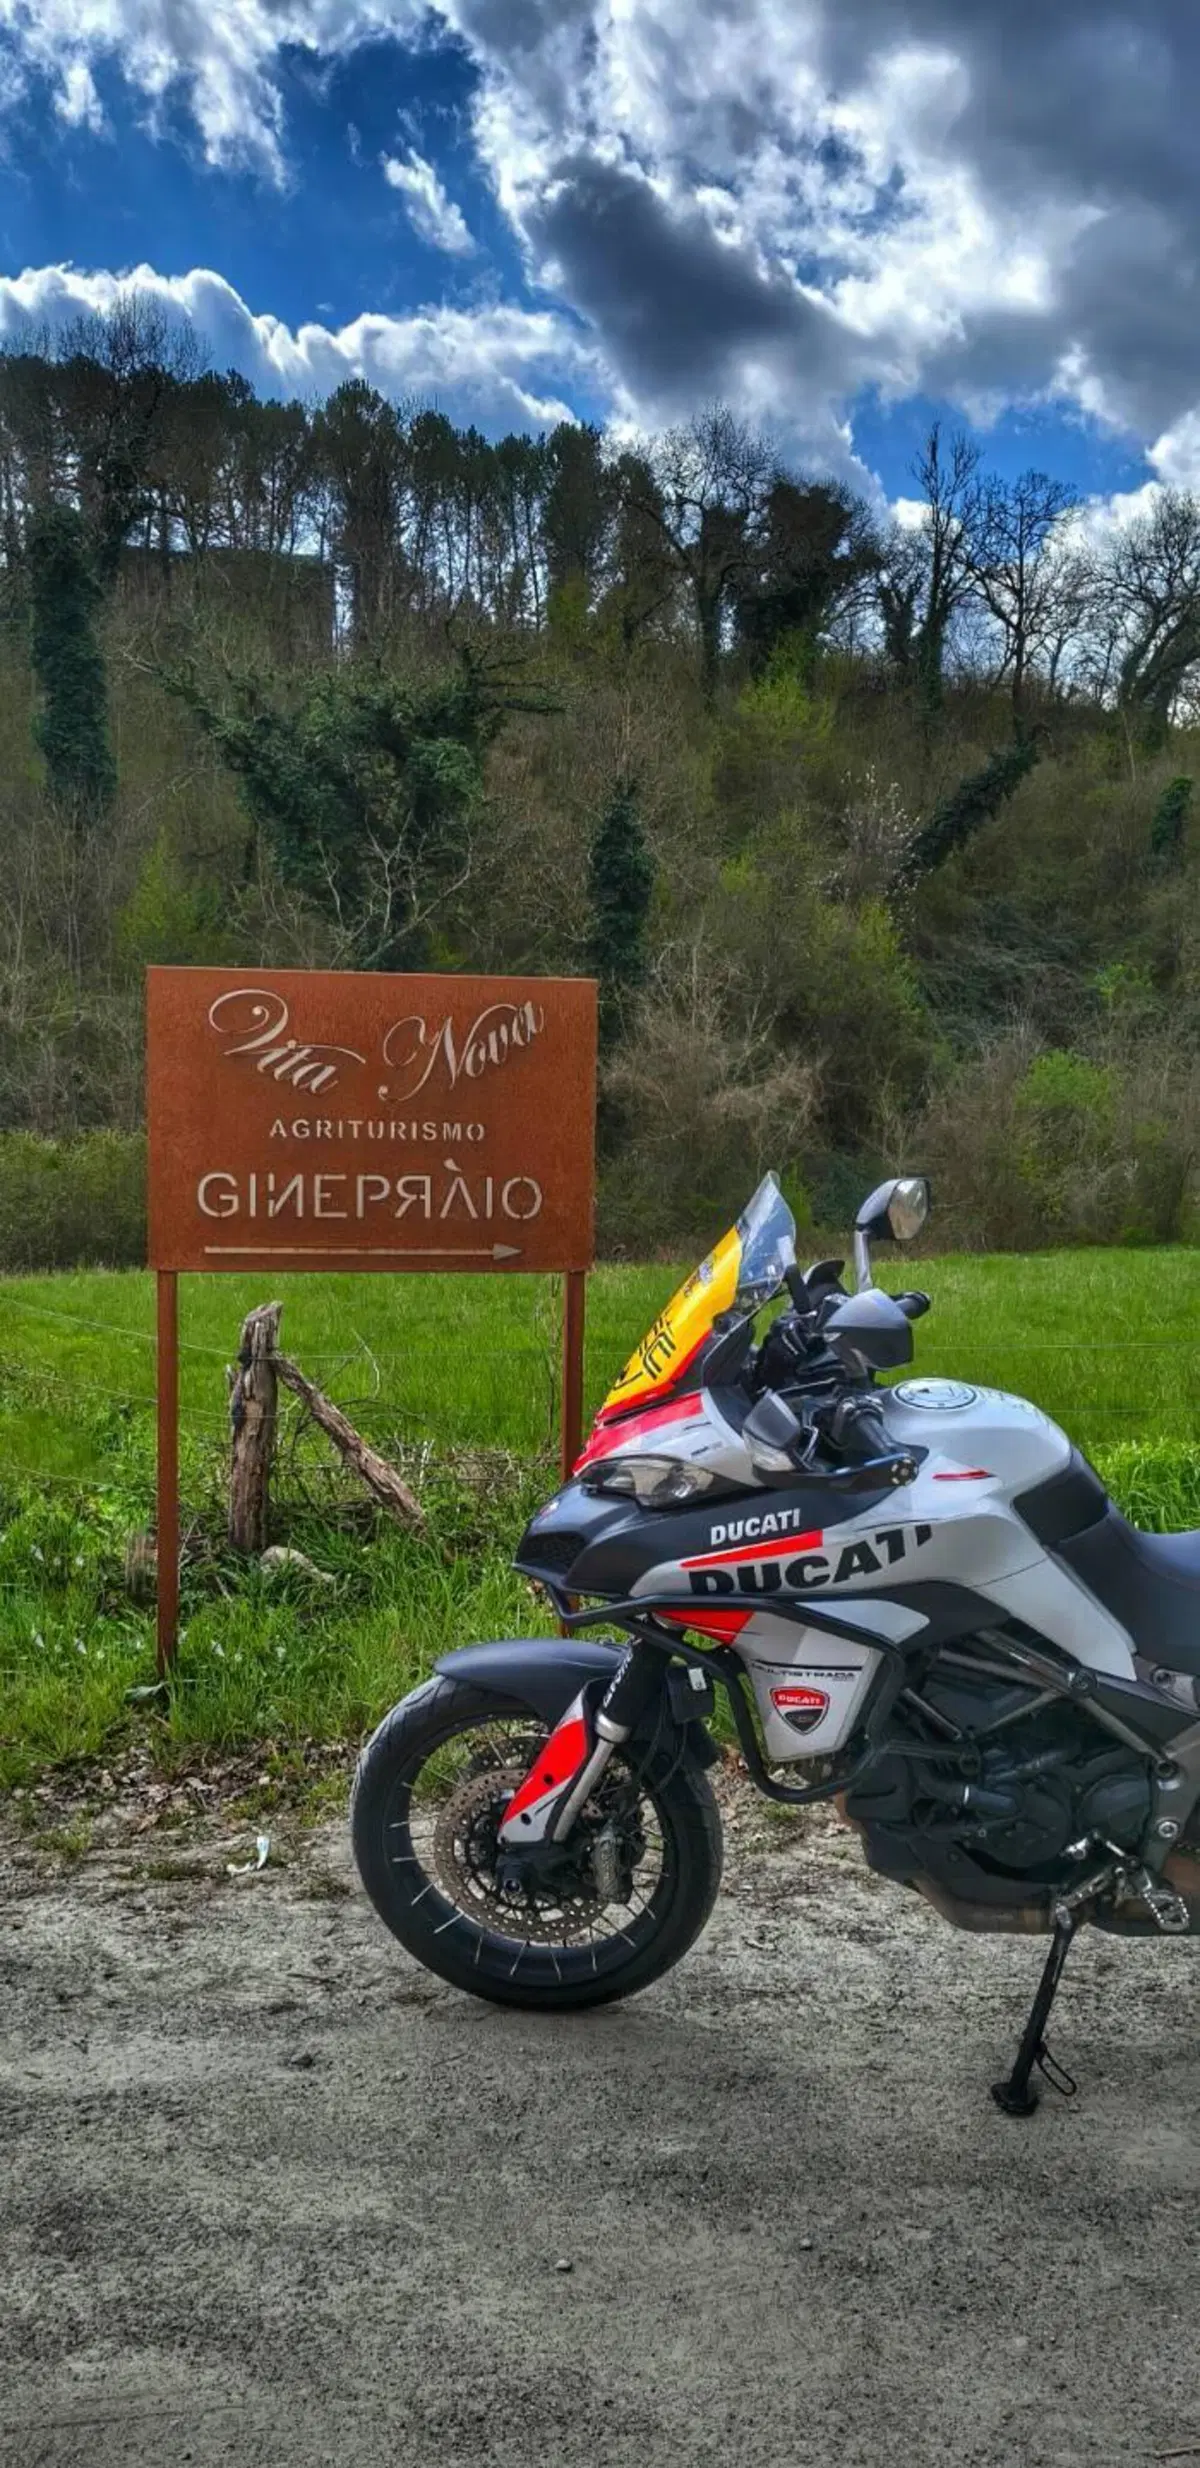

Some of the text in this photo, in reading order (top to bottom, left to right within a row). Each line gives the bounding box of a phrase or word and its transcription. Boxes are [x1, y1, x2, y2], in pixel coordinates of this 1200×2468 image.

[209, 988, 545, 1101] Vita Nova
[270, 1118, 486, 1142] AGRITURISMO
[710, 1508, 801, 1546] DUCATI
[688, 1523, 932, 1595] DUCATI
